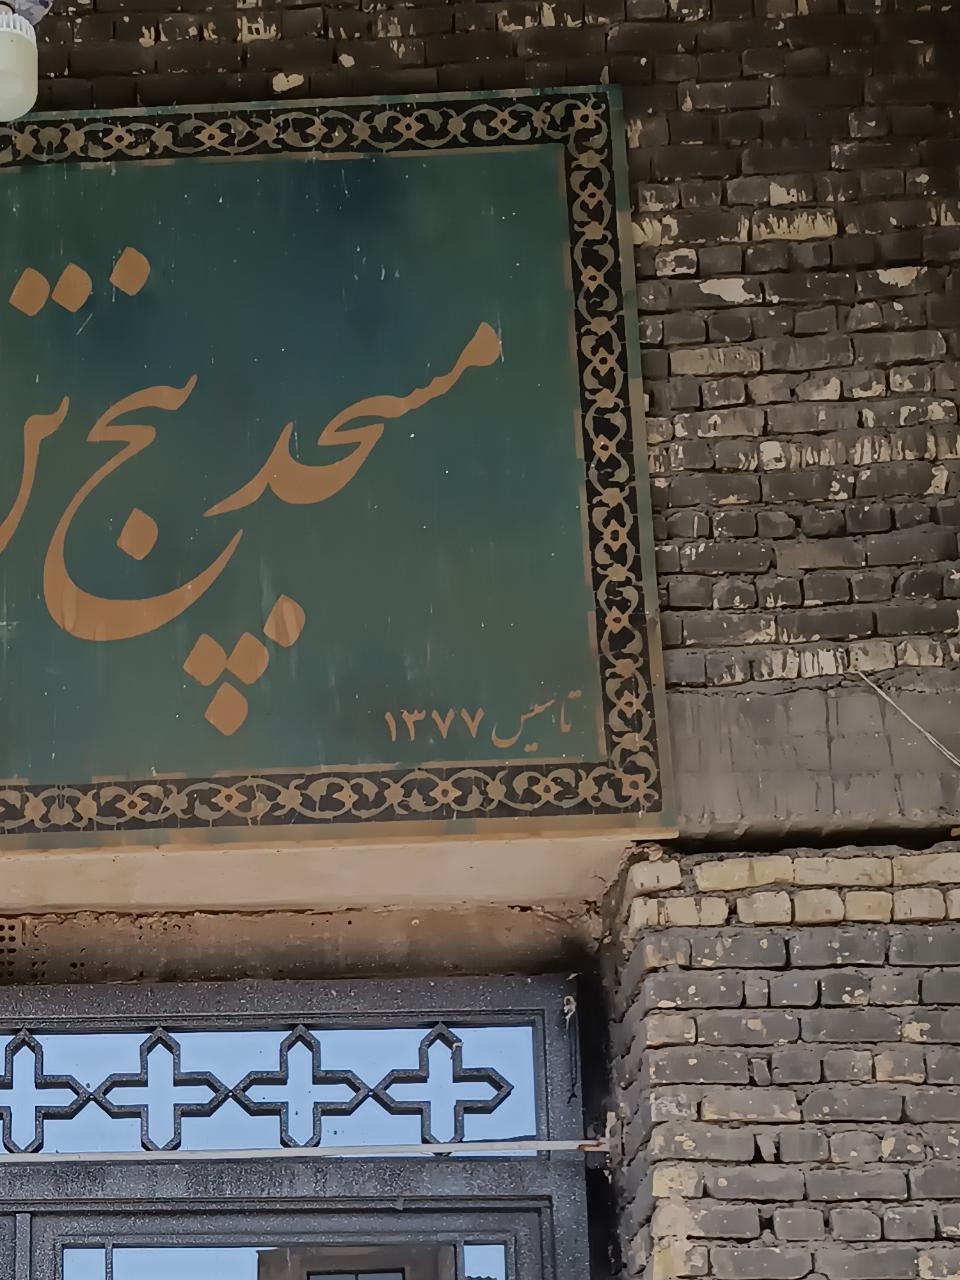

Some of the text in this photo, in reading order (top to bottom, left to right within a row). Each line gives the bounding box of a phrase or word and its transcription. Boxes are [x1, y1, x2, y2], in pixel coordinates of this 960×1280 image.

[44, 246, 269, 736] پنج
[204, 321, 501, 648] مسجد
[384, 707, 485, 742] ۱۳۷۷
